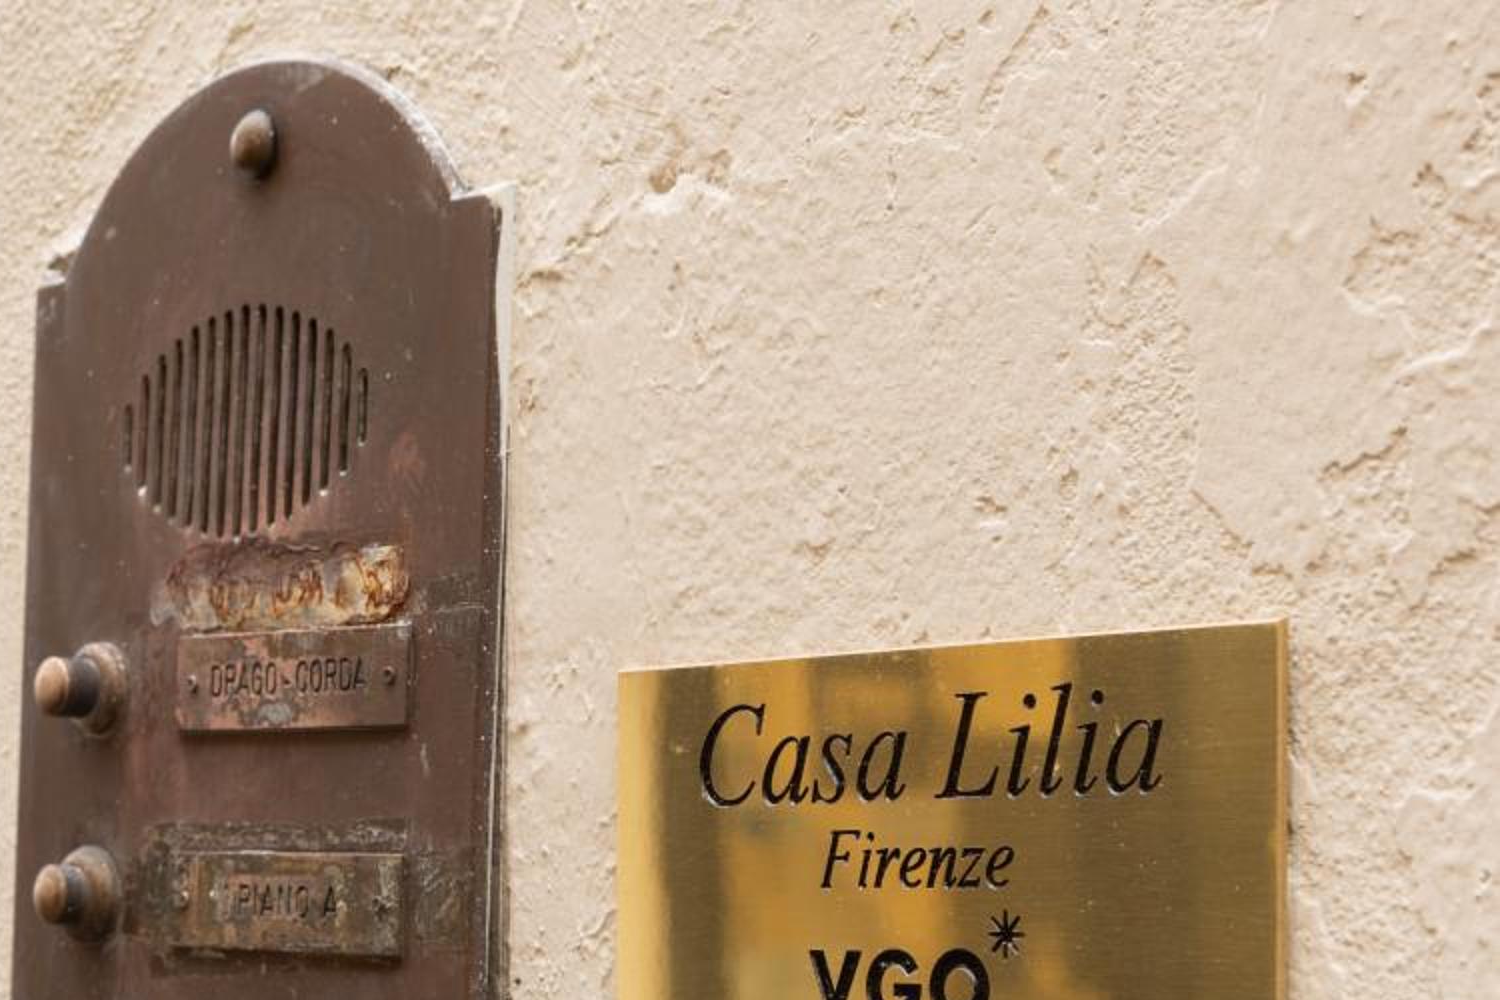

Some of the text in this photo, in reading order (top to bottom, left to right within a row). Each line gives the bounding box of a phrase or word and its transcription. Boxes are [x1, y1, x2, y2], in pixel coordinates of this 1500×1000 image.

[700, 682, 1164, 808] Casa Lilia
[820, 829, 1015, 891] Firenze
